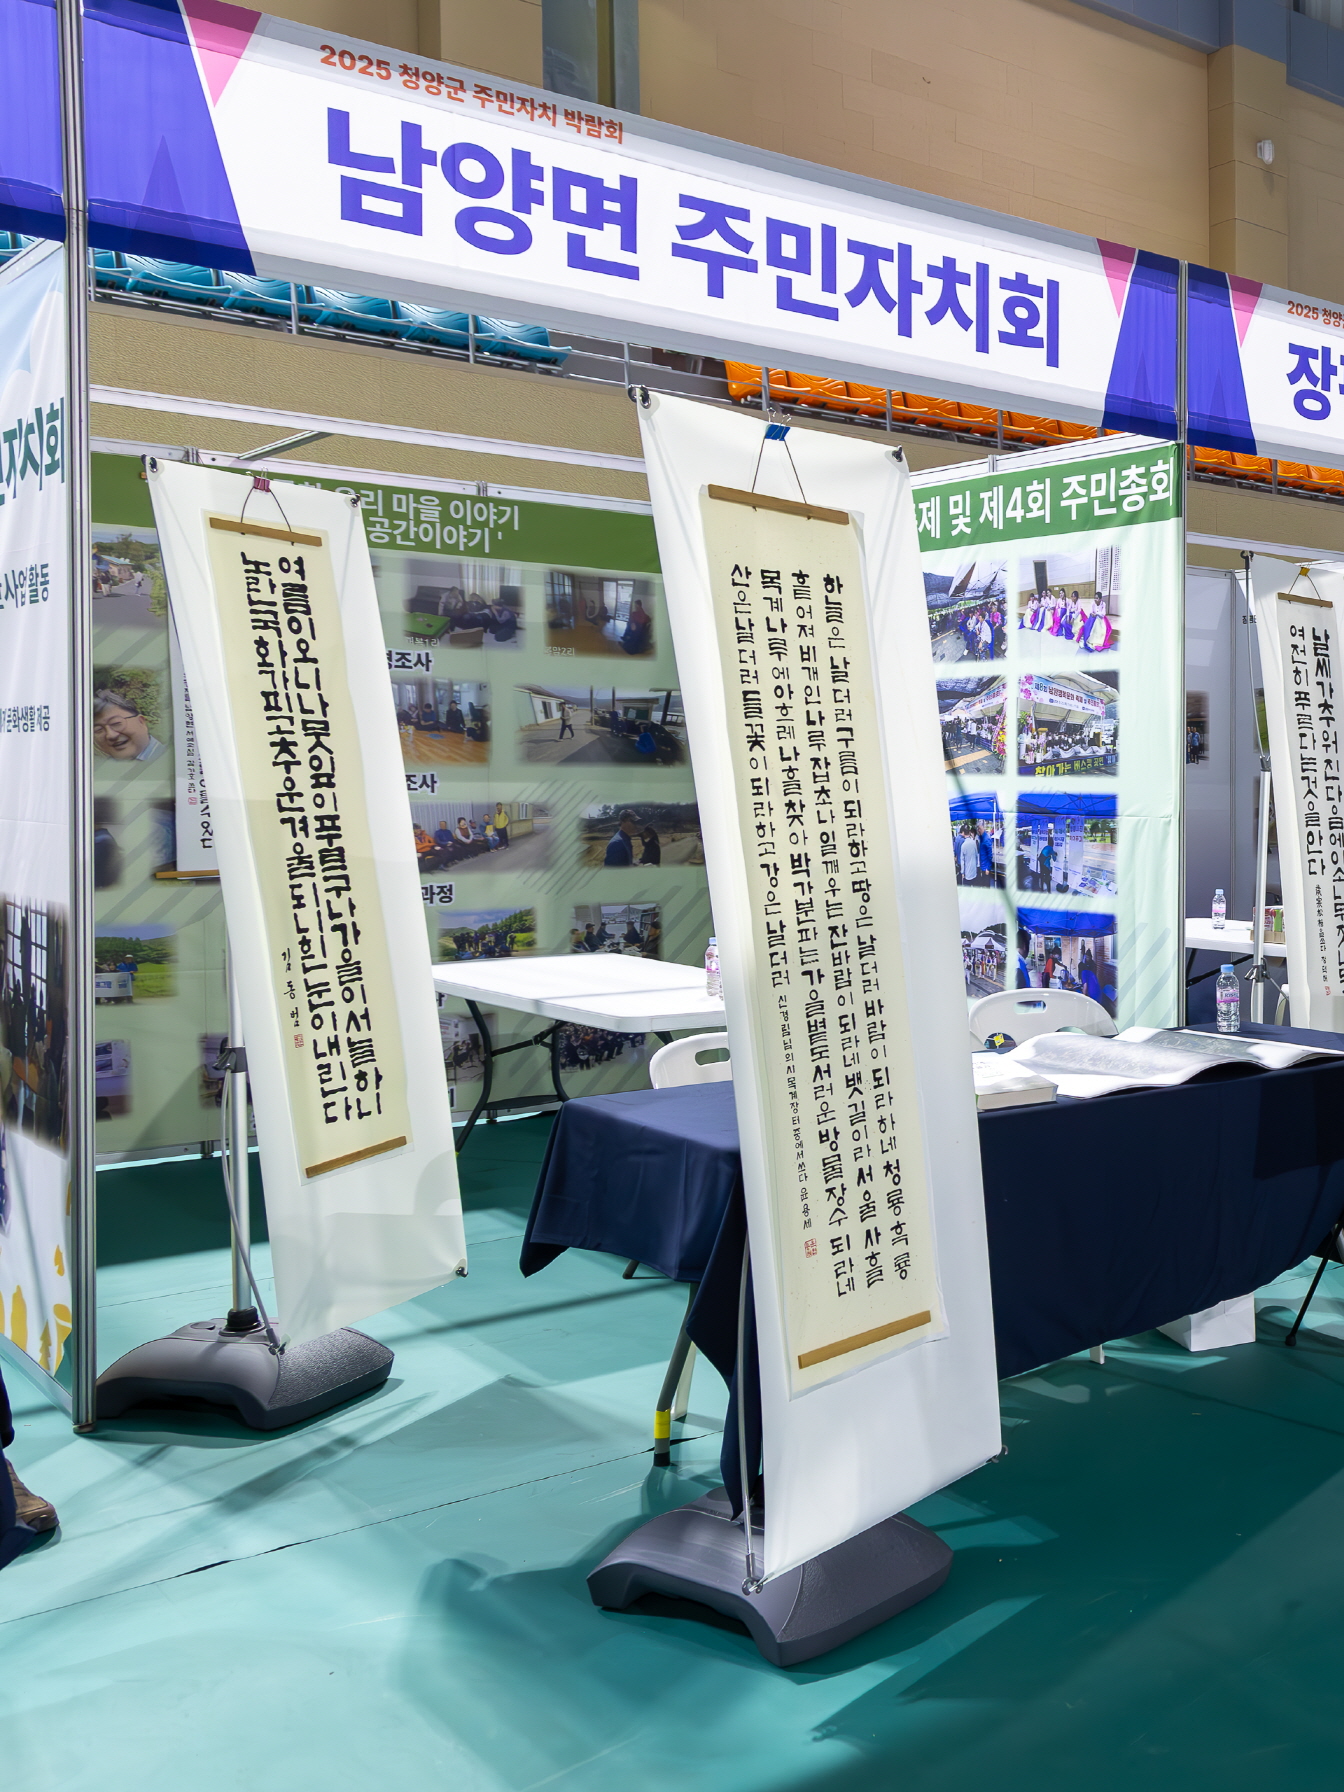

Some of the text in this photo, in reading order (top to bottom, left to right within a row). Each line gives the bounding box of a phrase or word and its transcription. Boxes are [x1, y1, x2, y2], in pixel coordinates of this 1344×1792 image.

[319, 44, 624, 145] 2025 청양군 주민자치 박람회
[327, 107, 1060, 368] 남양면 주민자치회
[1287, 300, 1319, 321] 2025
[0, 397, 65, 505] 자치회
[392, 493, 442, 522] 마을
[450, 499, 519, 531] 이야기
[912, 457, 1174, 539] 제 및 제4회 주민총회
[367, 517, 490, 553] 공간이야기
[0, 563, 50, 609] 사업활동
